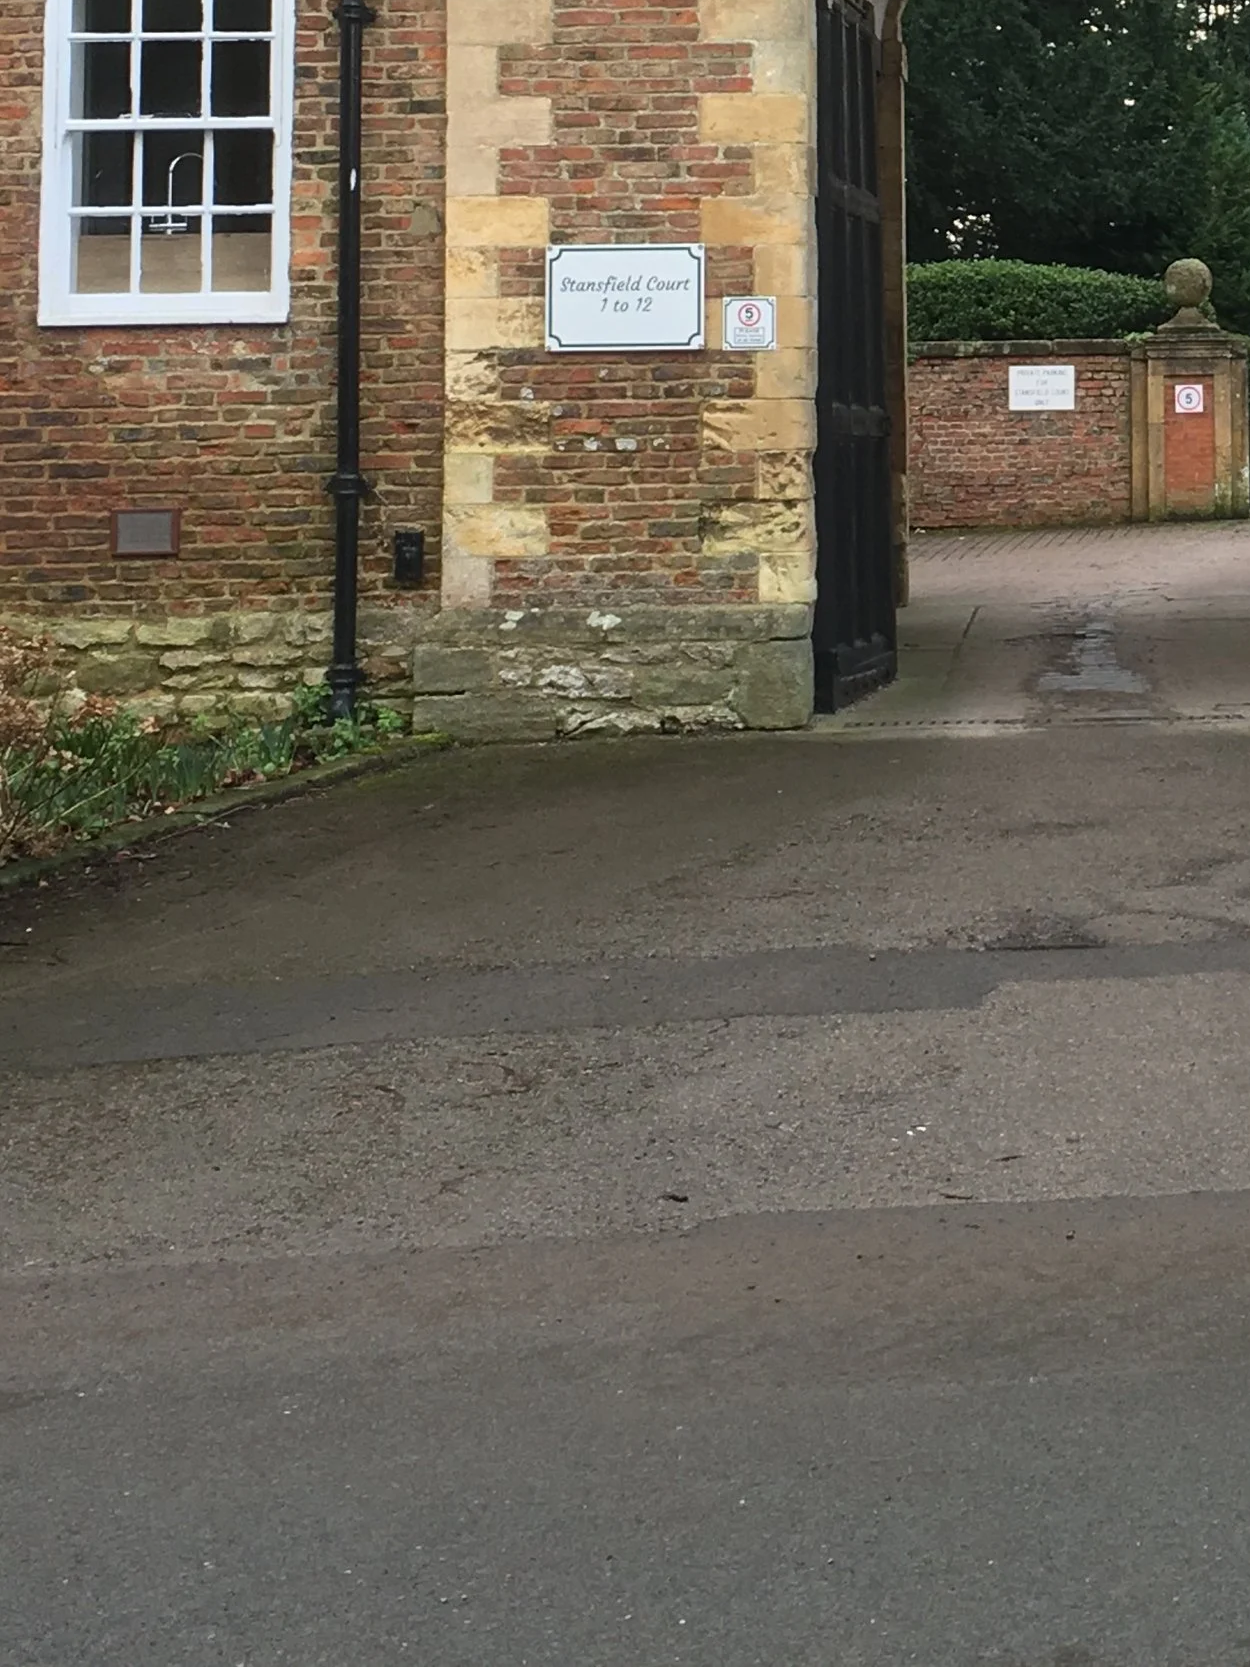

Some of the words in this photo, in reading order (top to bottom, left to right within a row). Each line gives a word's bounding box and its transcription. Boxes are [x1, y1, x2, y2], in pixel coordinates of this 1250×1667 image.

[560, 276, 642, 294] Stansfield
[646, 276, 690, 292] Court
[600, 298, 608, 312] 1
[613, 300, 629, 312] to
[636, 298, 653, 312] 12
[745, 307, 754, 320] 5
[1184, 393, 1193, 404] 5
